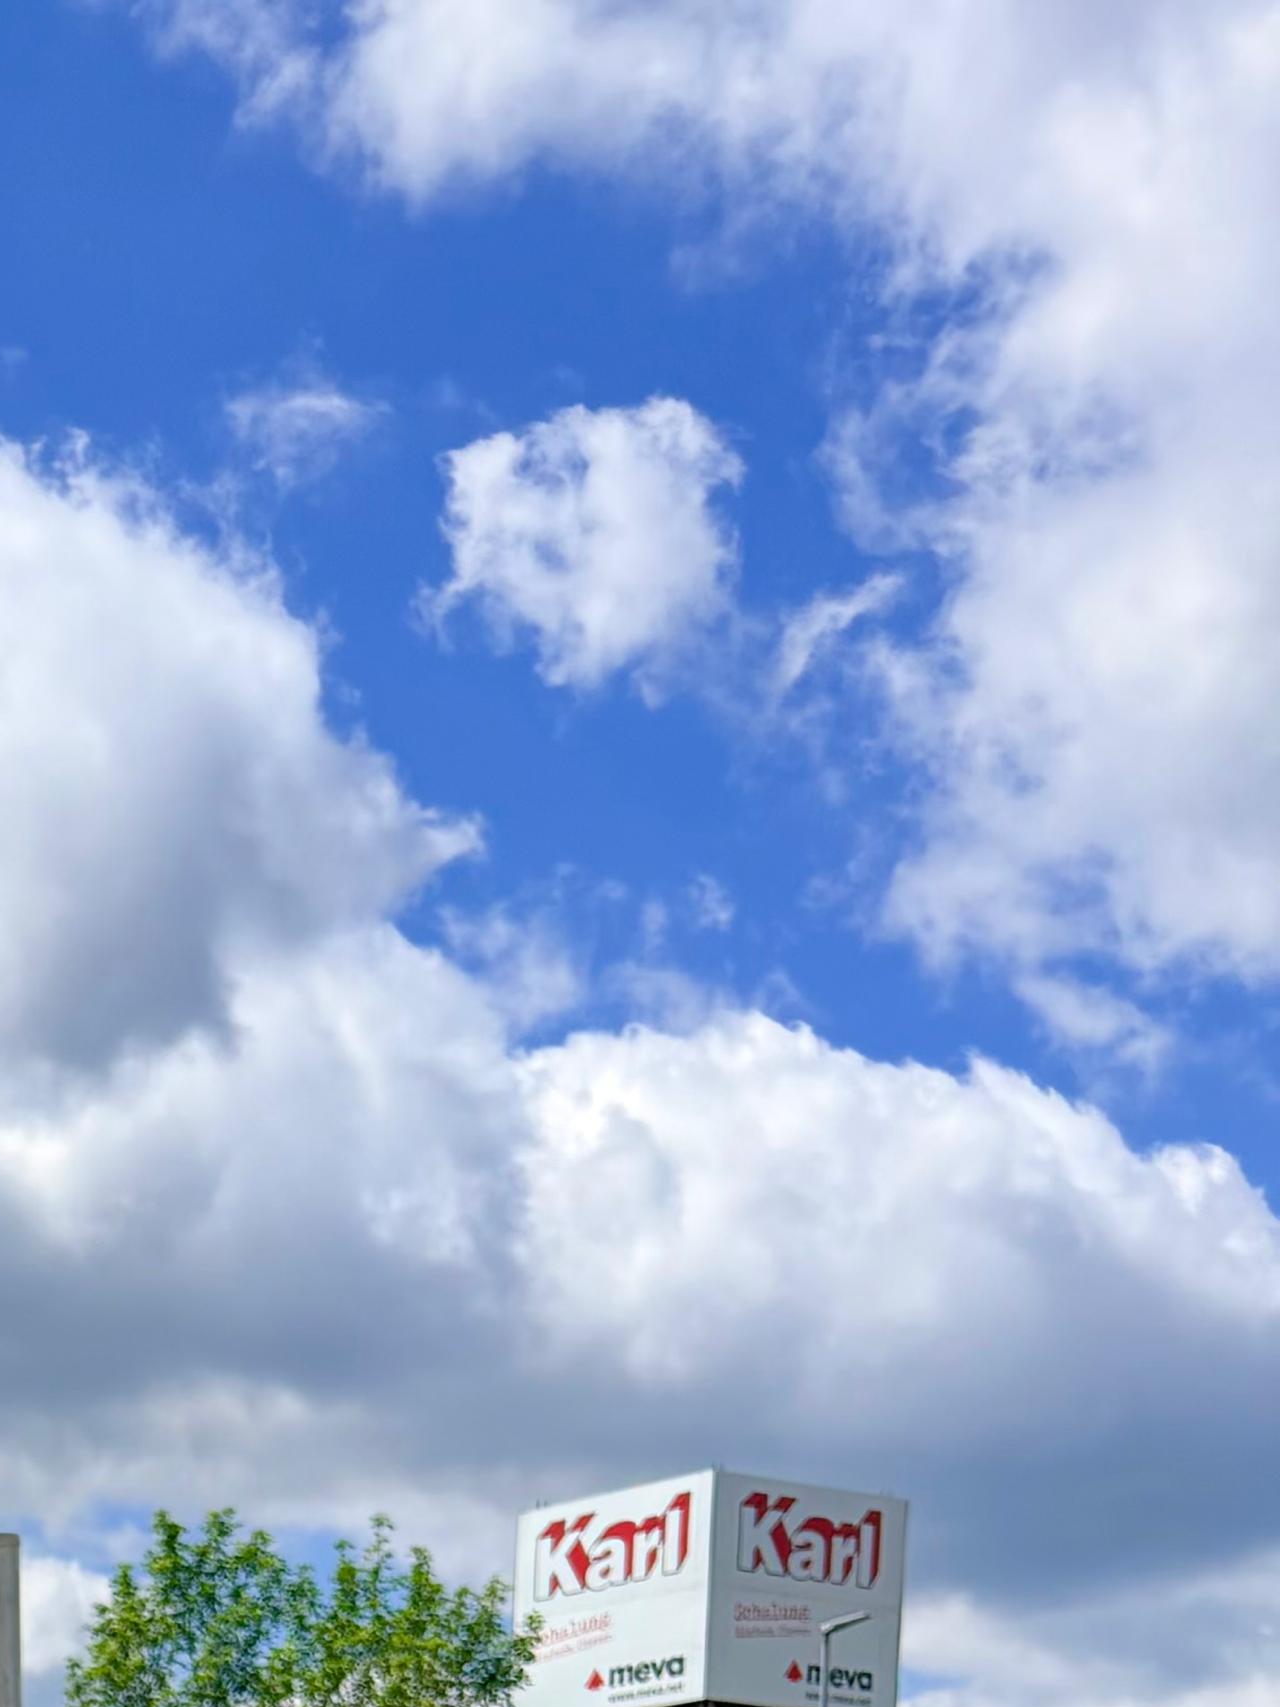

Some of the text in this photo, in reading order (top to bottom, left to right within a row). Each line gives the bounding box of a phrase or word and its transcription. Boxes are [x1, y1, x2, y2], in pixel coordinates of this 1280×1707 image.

[534, 1491, 691, 1602] Karl
[737, 1492, 882, 1590] Karl
[608, 1655, 685, 1688] meva
